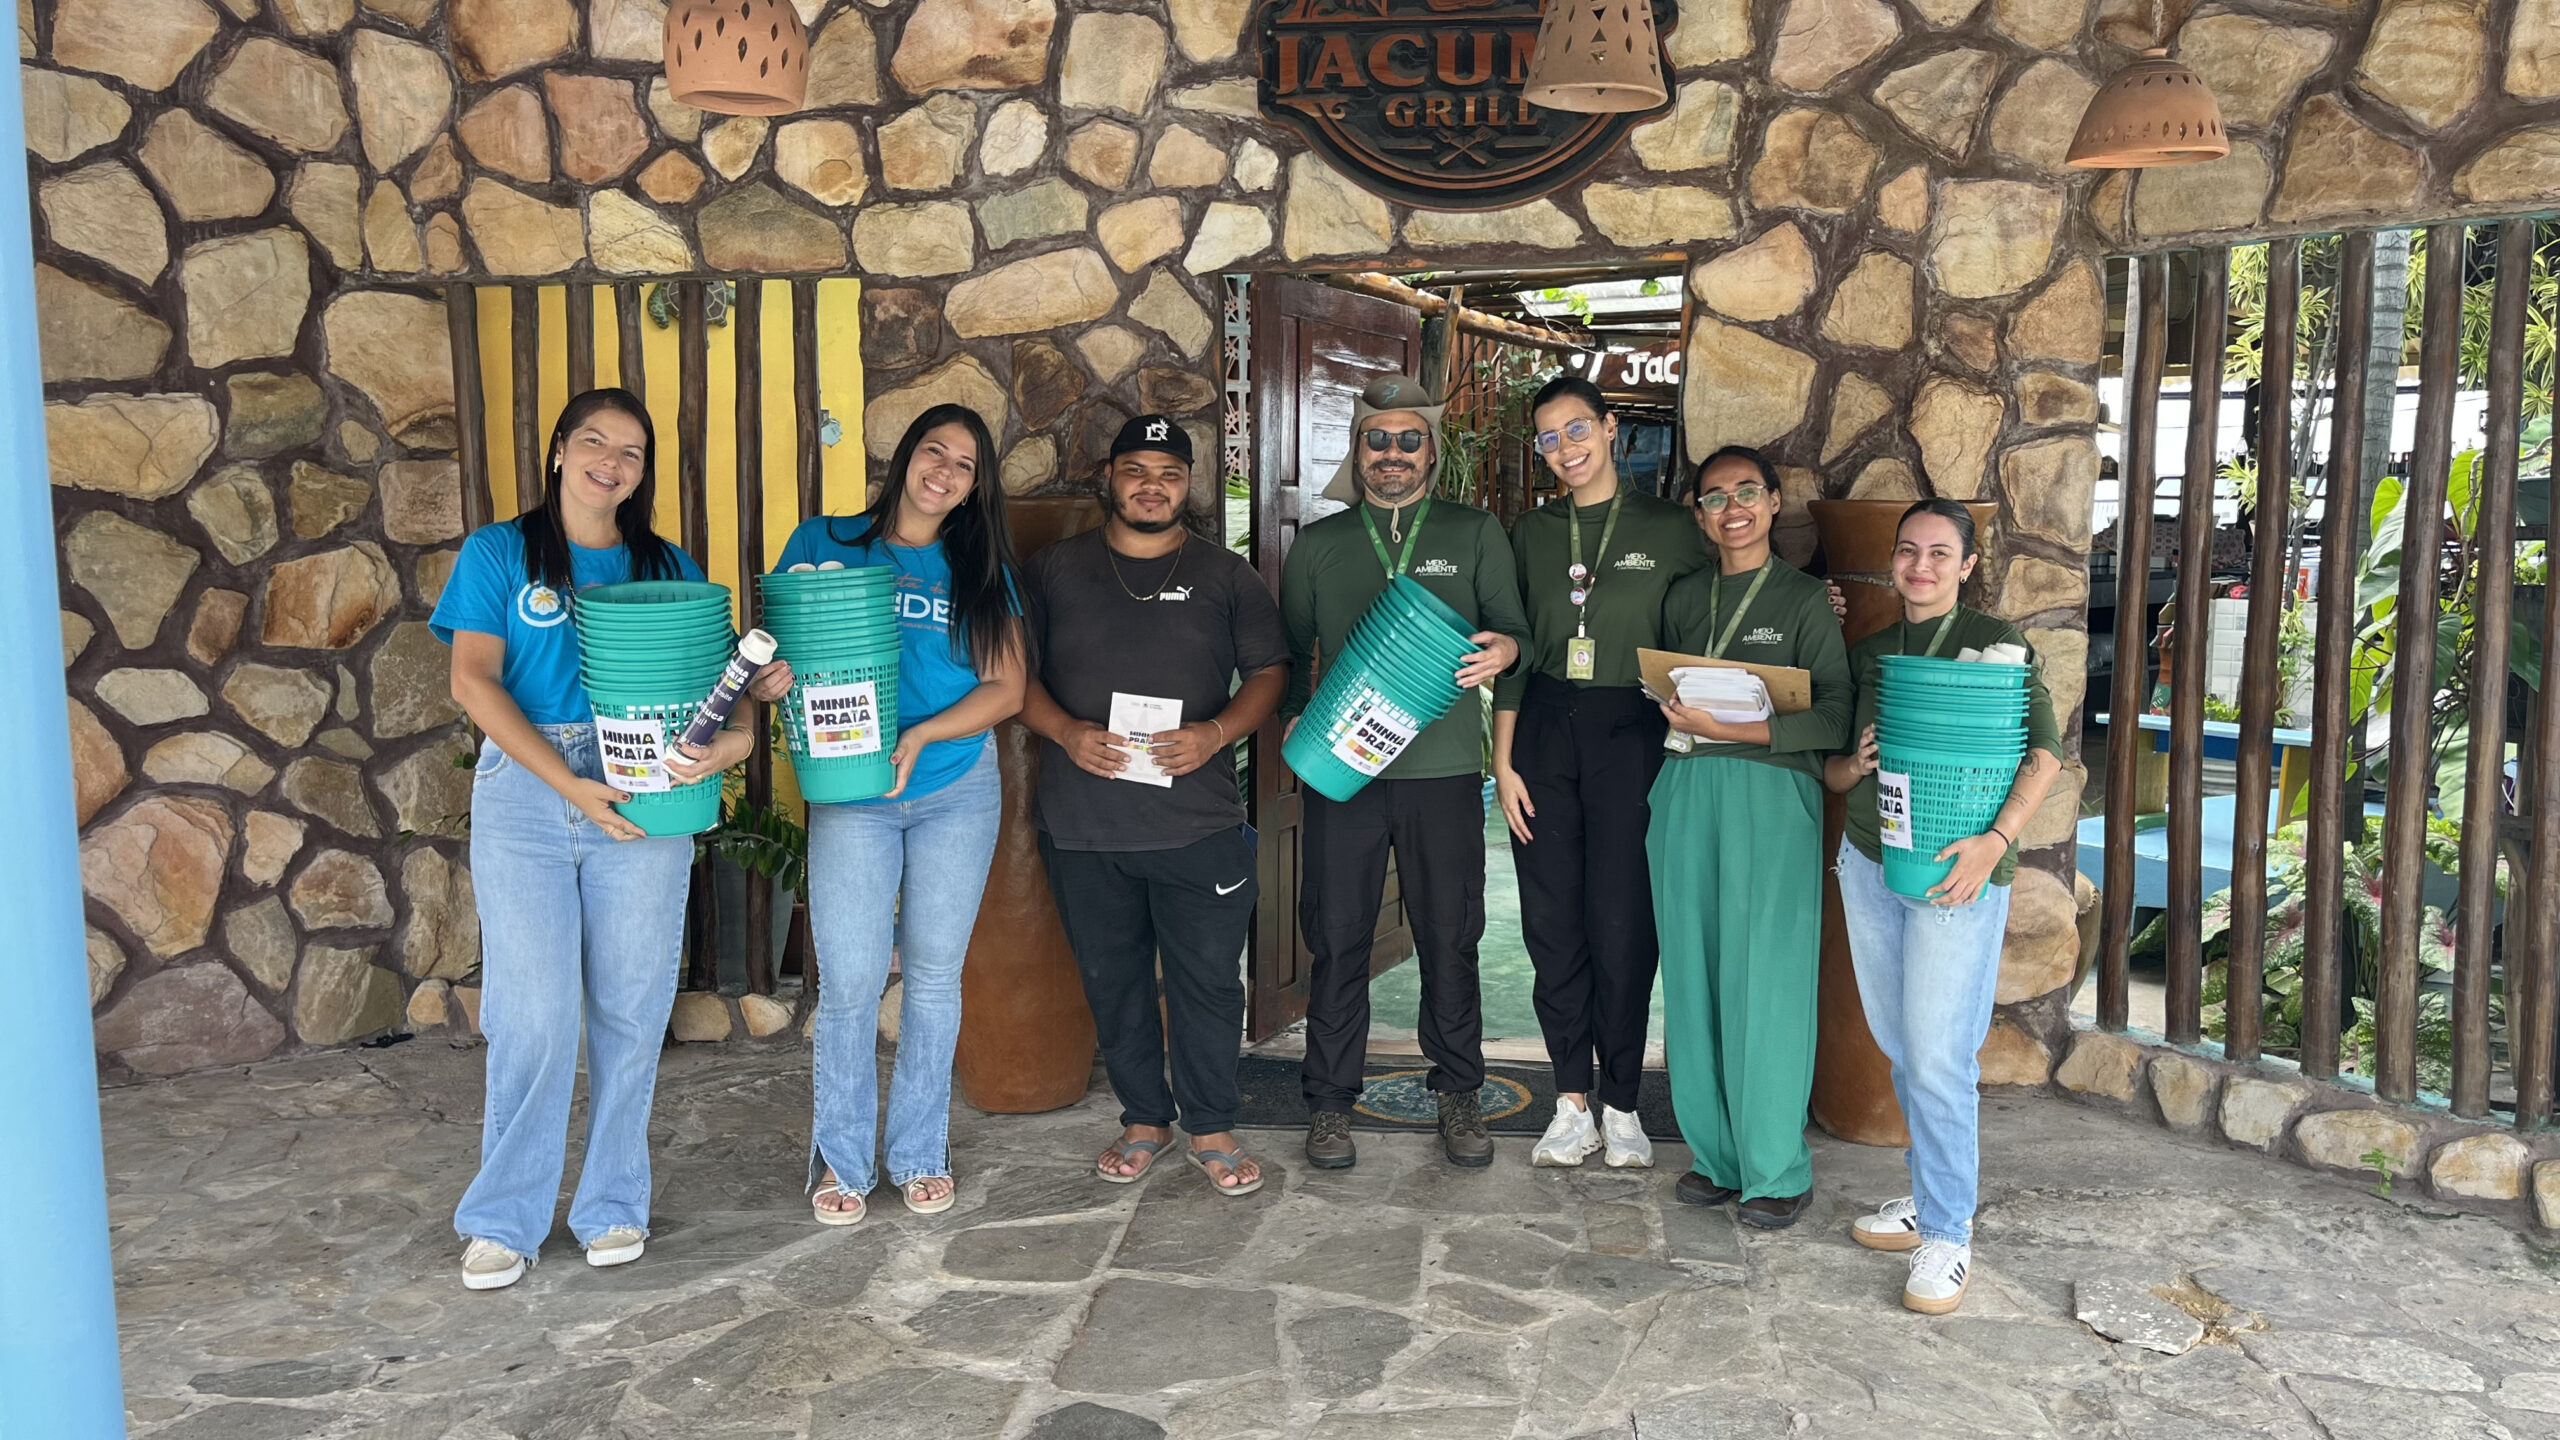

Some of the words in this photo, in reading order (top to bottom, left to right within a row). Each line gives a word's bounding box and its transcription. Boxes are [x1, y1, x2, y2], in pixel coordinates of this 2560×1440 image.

[1385, 95, 1540, 128] GRILL
[1425, 559, 1448, 567] MEIO
[1613, 560, 1656, 568] AMBIENTE
[1625, 552, 1647, 560] MEIO
[1414, 565, 1458, 574] AMBIENTE
[1160, 592, 1186, 602] PUMA
[894, 591, 955, 626] DE
[1742, 633, 1784, 642] AMBIENTE
[1752, 627, 1774, 635] MEIO
[810, 694, 870, 711] MINHA
[812, 709, 872, 726] PRAIA
[602, 729, 656, 745] MINHA
[1365, 717, 1406, 746] MINHA
[1356, 727, 1397, 756] PRAIA
[604, 744, 658, 760] PRAIA
